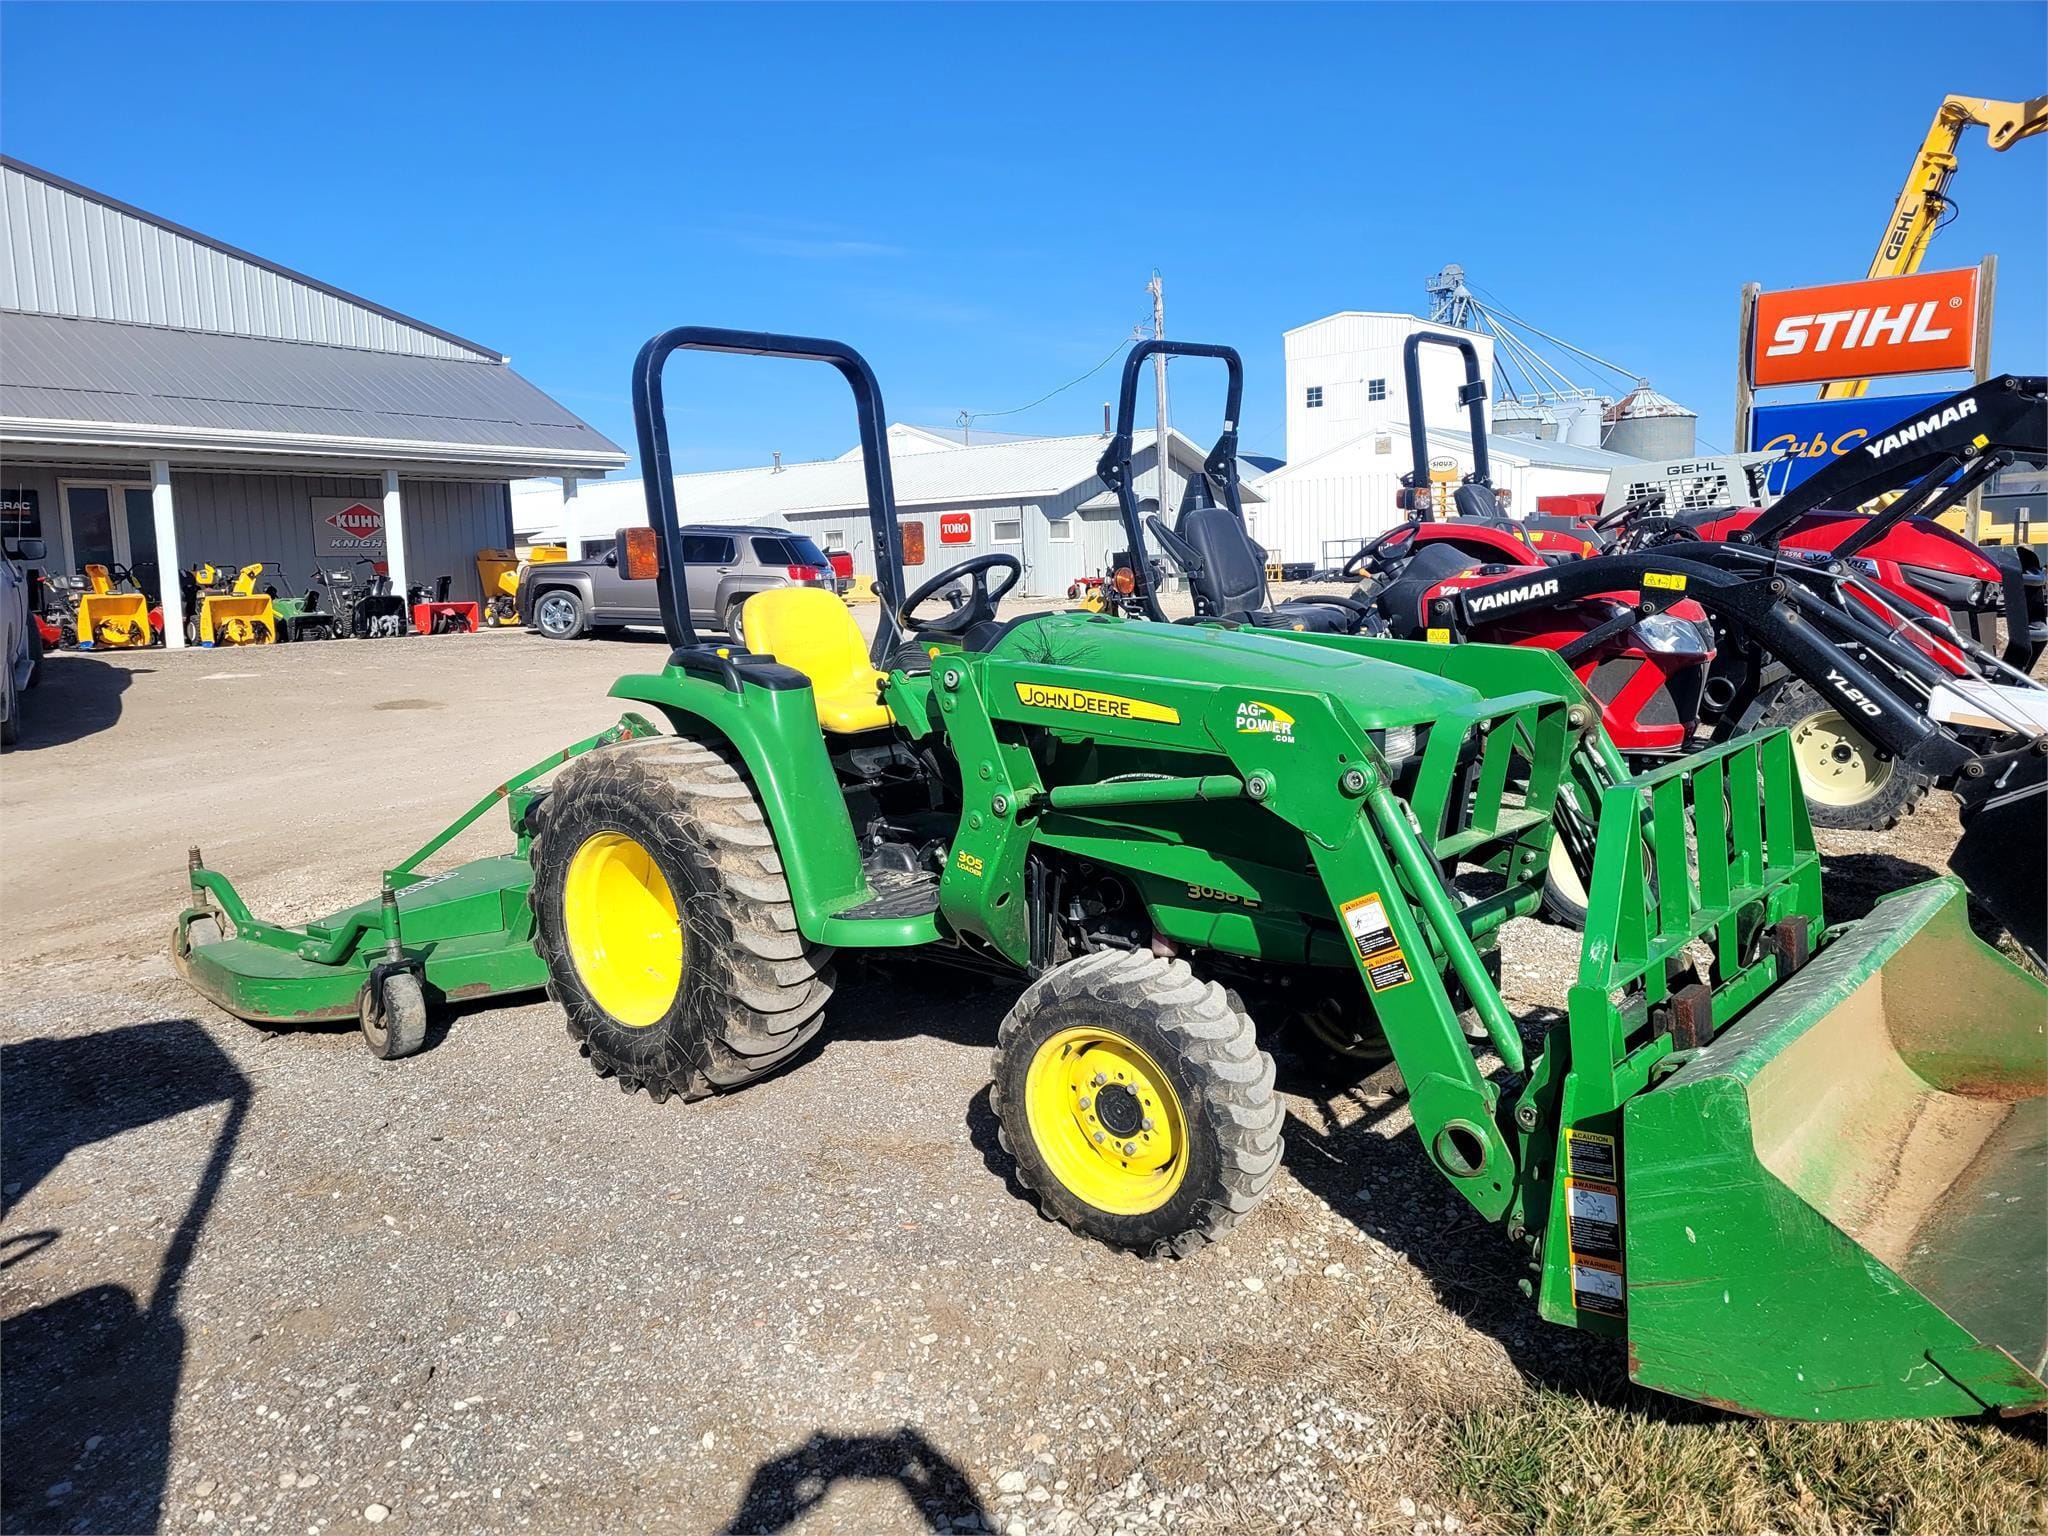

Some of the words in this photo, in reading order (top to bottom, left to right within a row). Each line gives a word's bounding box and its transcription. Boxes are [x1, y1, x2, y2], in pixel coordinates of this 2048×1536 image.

[1885, 204, 1920, 260] GEHL
[1766, 301, 1952, 357] STIHL
[1865, 398, 1978, 458] YANMAR
[1761, 431, 1828, 458] Cub
[1831, 428, 1868, 456] C
[1667, 462, 1724, 475] GEHL
[336, 514, 384, 528] KUHN
[942, 523, 969, 534] TORO
[331, 539, 384, 548] KNIGH
[1468, 579, 1559, 613] YANMAR
[1826, 668, 1882, 717] YL210
[1024, 687, 1069, 708] JOHN
[1073, 692, 1131, 717] DEERE
[1237, 702, 1267, 716] AG-
[1236, 716, 1292, 735] POWER
[1272, 734, 1295, 743] .COM
[958, 850, 983, 870] 305
[956, 862, 982, 878] LOADER
[1577, 1131, 1609, 1143] CAUTION
[1577, 1180, 1611, 1193] WARNING
[1582, 1259, 1617, 1272] WARNING
